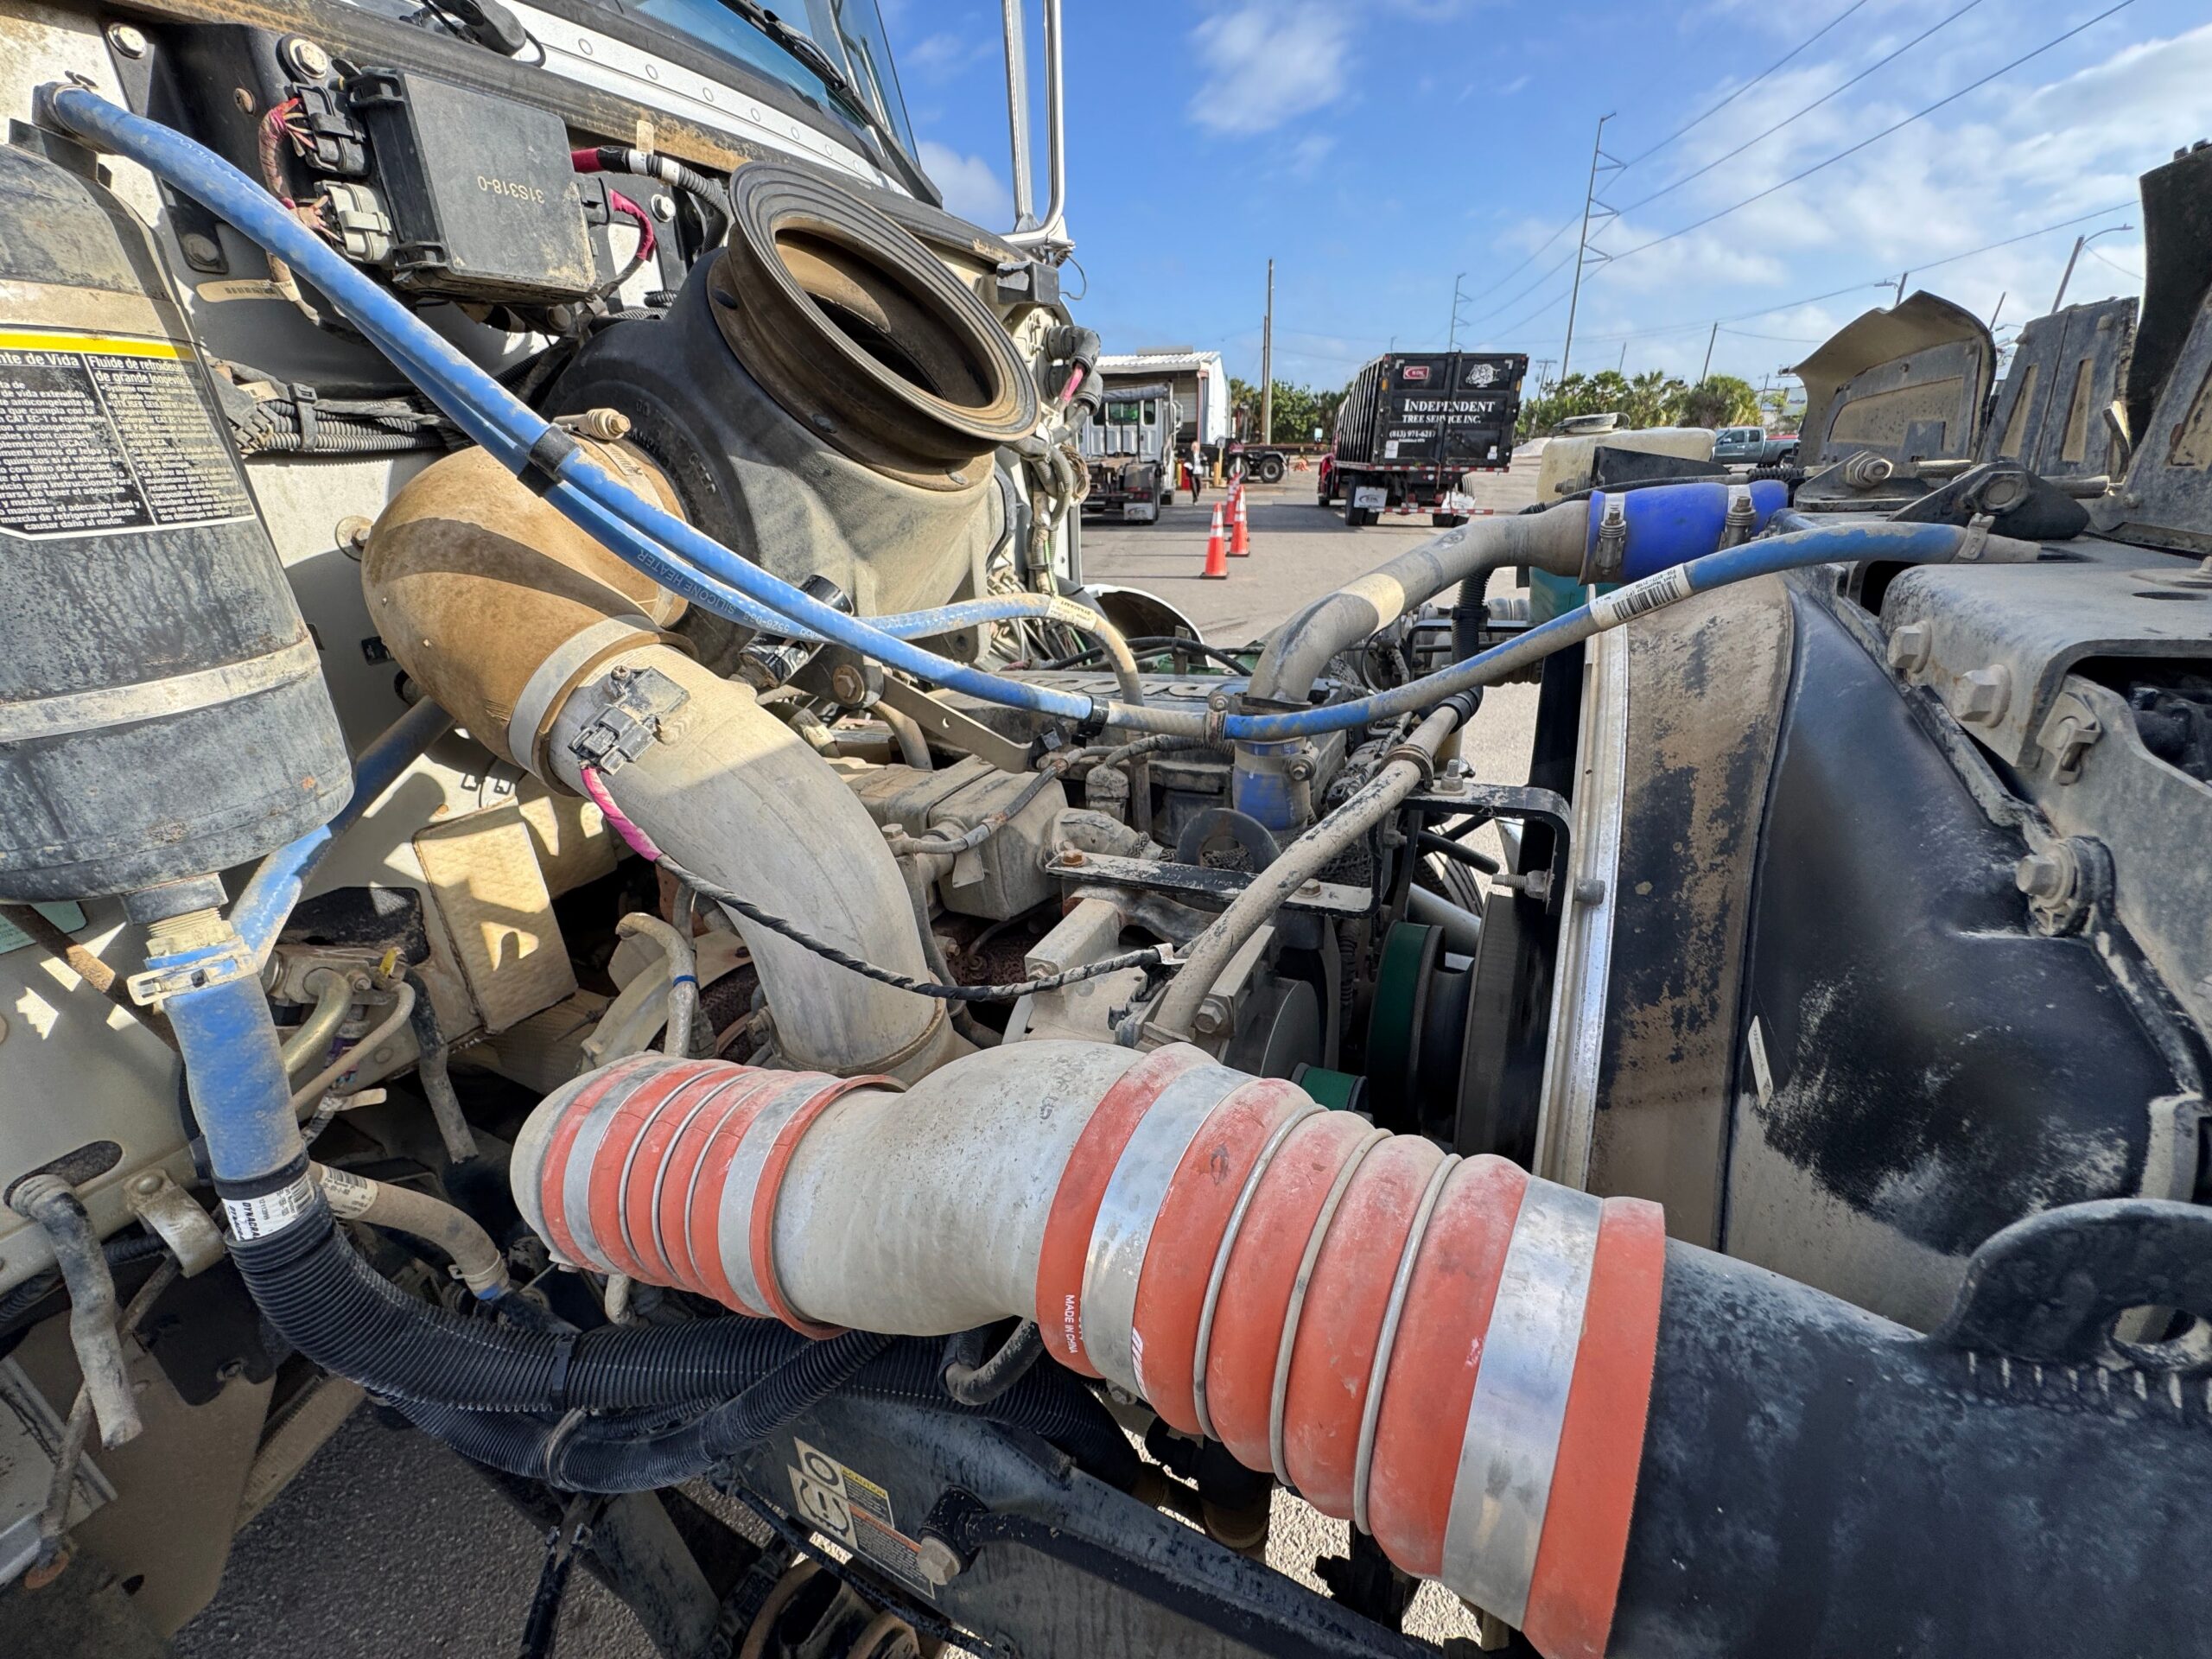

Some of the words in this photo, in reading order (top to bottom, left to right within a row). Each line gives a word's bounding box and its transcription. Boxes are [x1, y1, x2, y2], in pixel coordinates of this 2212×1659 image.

[477, 175, 545, 205] 31S318-0
[24, 353, 45, 365] de
[44, 353, 79, 366] Vida
[87, 355, 125, 369] Fluide
[125, 358, 139, 369] de
[94, 371, 111, 381] de
[112, 372, 149, 384] grande
[1, 389, 15, 397] de
[39, 390, 86, 398] extendida
[10, 398, 81, 408] anticongelante
[7, 408, 27, 416] que
[29, 407, 66, 416] cumpla
[1402, 415, 1425, 423] TREE
[16, 423, 92, 432] anticongelantes
[54, 432, 95, 441] cualquier
[57, 440, 89, 448] (SCAs)
[34, 448, 64, 456] filtros
[69, 463, 111, 472] enfriador
[10, 474, 21, 482] el
[22, 473, 60, 481] manual
[61, 471, 77, 480] del
[78, 471, 118, 481] operador
[25, 481, 49, 491] para
[29, 489, 44, 498] de
[45, 488, 71, 497] tener
[73, 487, 82, 496] el
[83, 486, 126, 495] adecuado
[7, 506, 54, 516] mantener
[67, 502, 112, 512] adecuado
[113, 499, 136, 509] nivel
[10, 498, 48, 507] mezcla
[2, 515, 37, 524] mezcla
[38, 513, 53, 522] de
[53, 510, 109, 521] refrigerante
[109, 508, 137, 518] puede
[24, 522, 59, 531] causar
[60, 519, 85, 528] daño
[86, 517, 97, 526] al
[97, 517, 126, 525] motor.
[637, 548, 684, 587] HEATER
[683, 582, 737, 615] SILICONE
[1064, 1294, 1075, 1323] MADE
[1064, 1324, 1074, 1334] IN
[1065, 1332, 1078, 1353] CHINA
